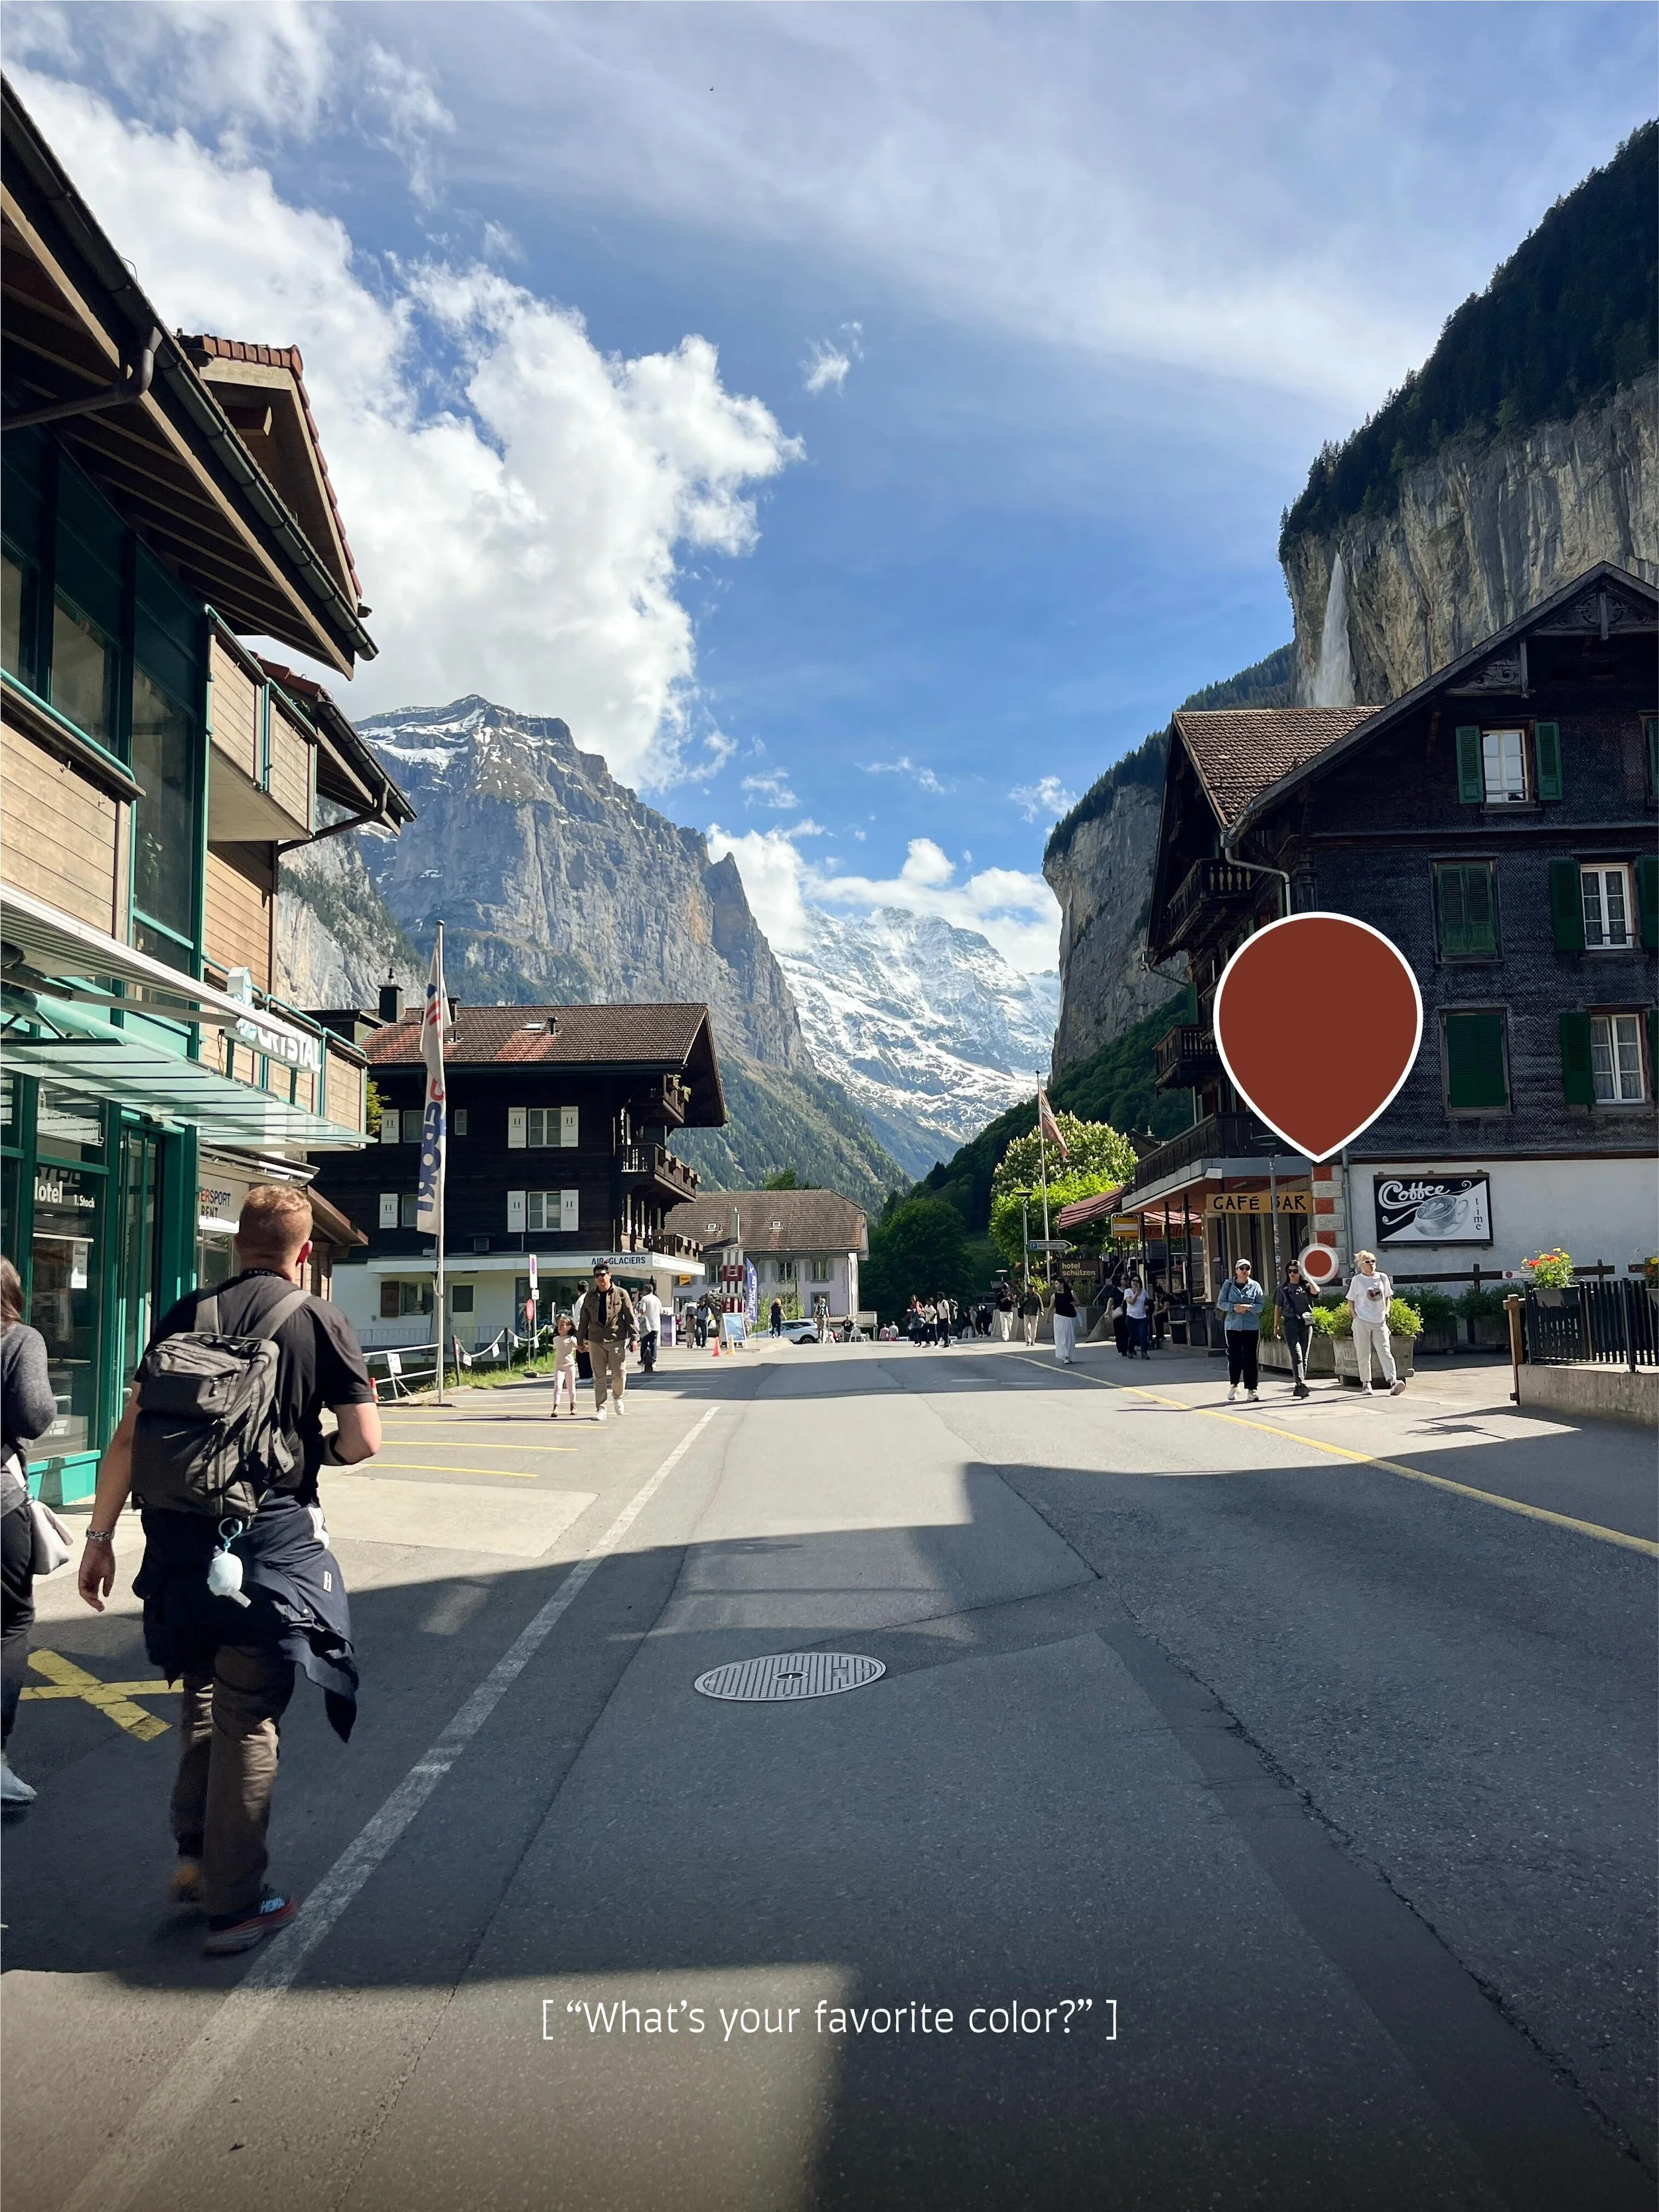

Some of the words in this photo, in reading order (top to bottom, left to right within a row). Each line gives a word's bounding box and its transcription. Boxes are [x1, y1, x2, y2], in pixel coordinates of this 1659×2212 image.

[80, 1195, 96, 1208] Stock
[200, 1189, 231, 1207] ERSPORT
[1214, 1195, 1260, 1211] CAFÉ
[1378, 1180, 1450, 1209] Coffee
[201, 1205, 218, 1218] RENT
[1474, 1197, 1483, 1230] time
